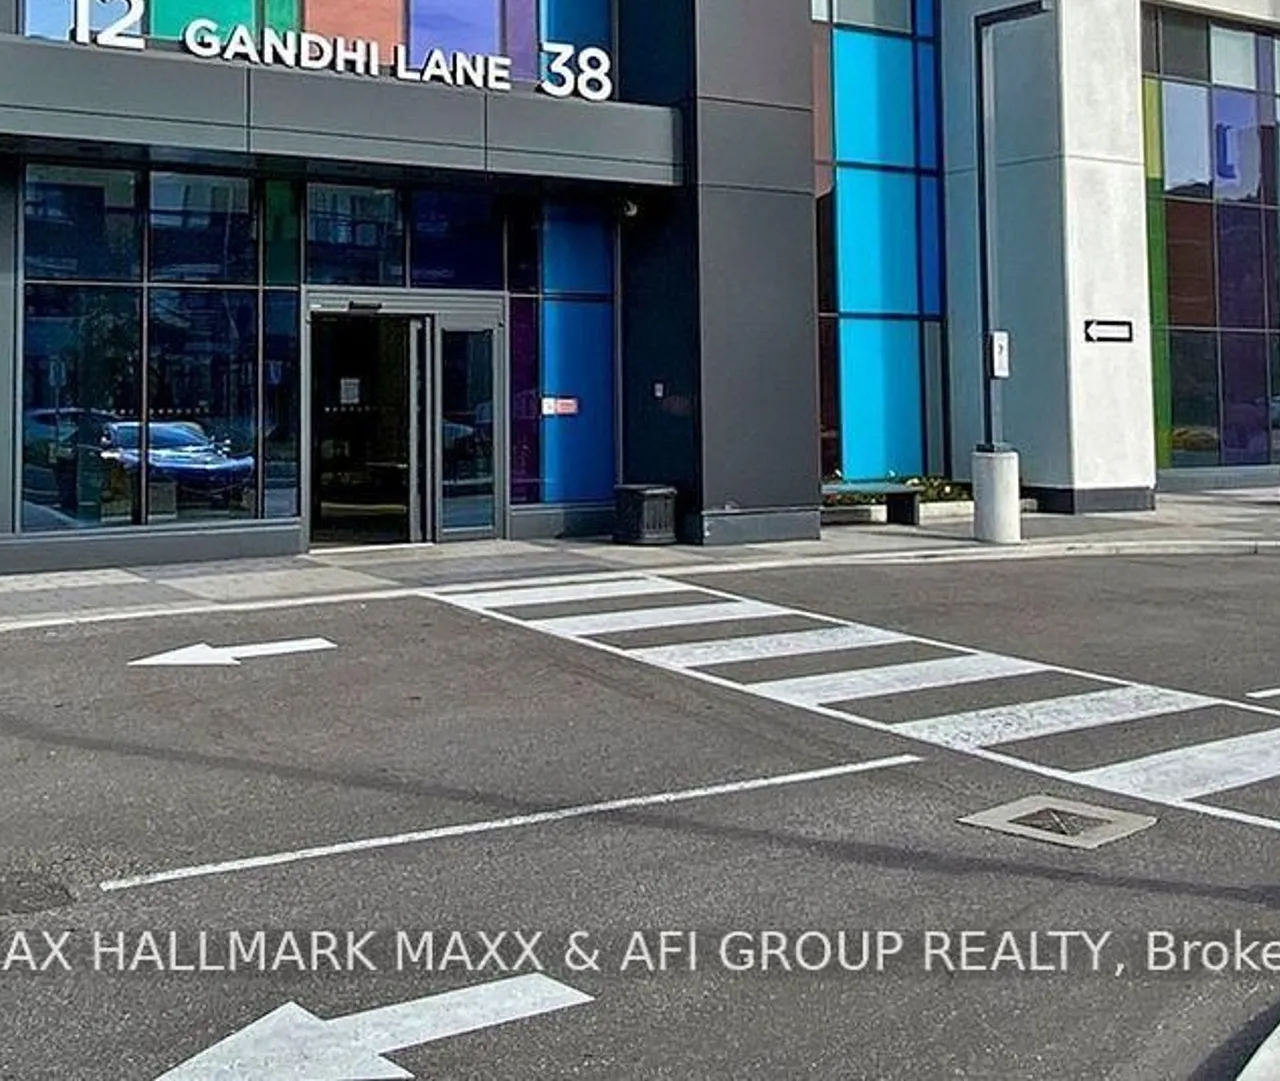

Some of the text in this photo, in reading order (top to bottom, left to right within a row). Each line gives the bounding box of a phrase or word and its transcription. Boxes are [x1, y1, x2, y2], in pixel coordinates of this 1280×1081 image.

[182, 18, 380, 77] GANDHI
[393, 43, 513, 92] LANE
[540, 41, 613, 102] 38
